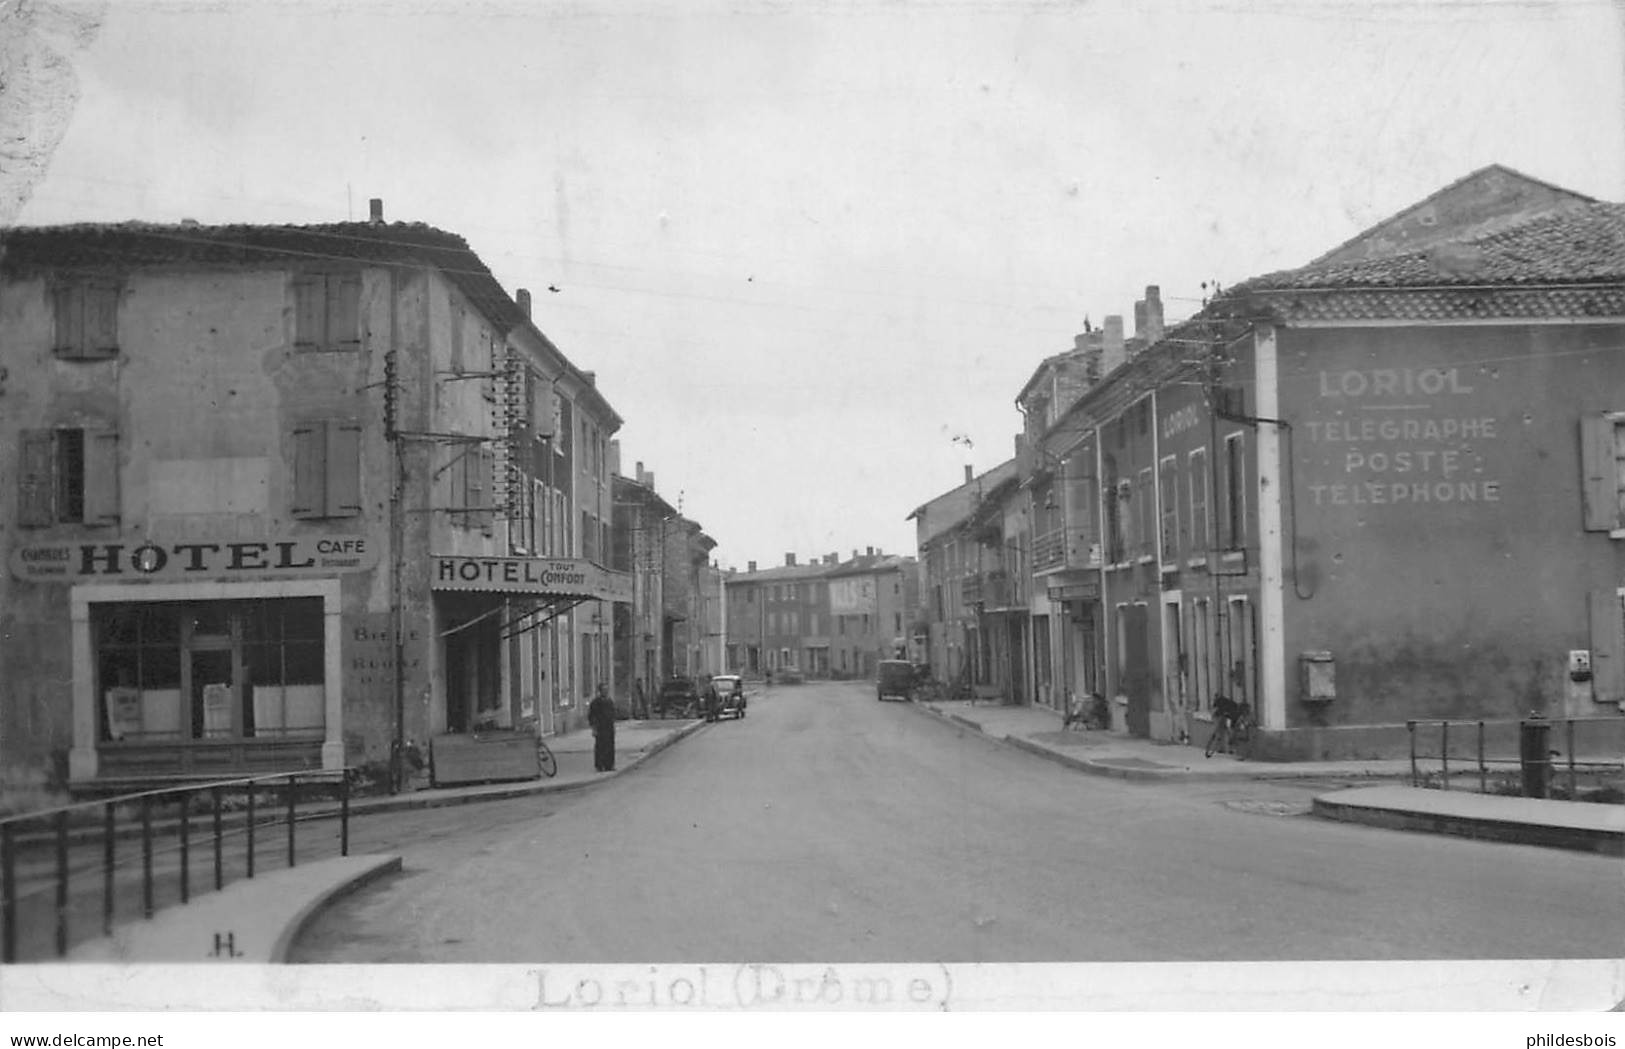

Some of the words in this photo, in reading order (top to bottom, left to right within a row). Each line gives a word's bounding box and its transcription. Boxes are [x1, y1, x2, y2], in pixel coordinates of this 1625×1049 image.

[1319, 368, 1474, 396] LORIOL
[1305, 418, 1497, 442] TELEGRAPHE
[549, 562, 575, 571] TOUT
